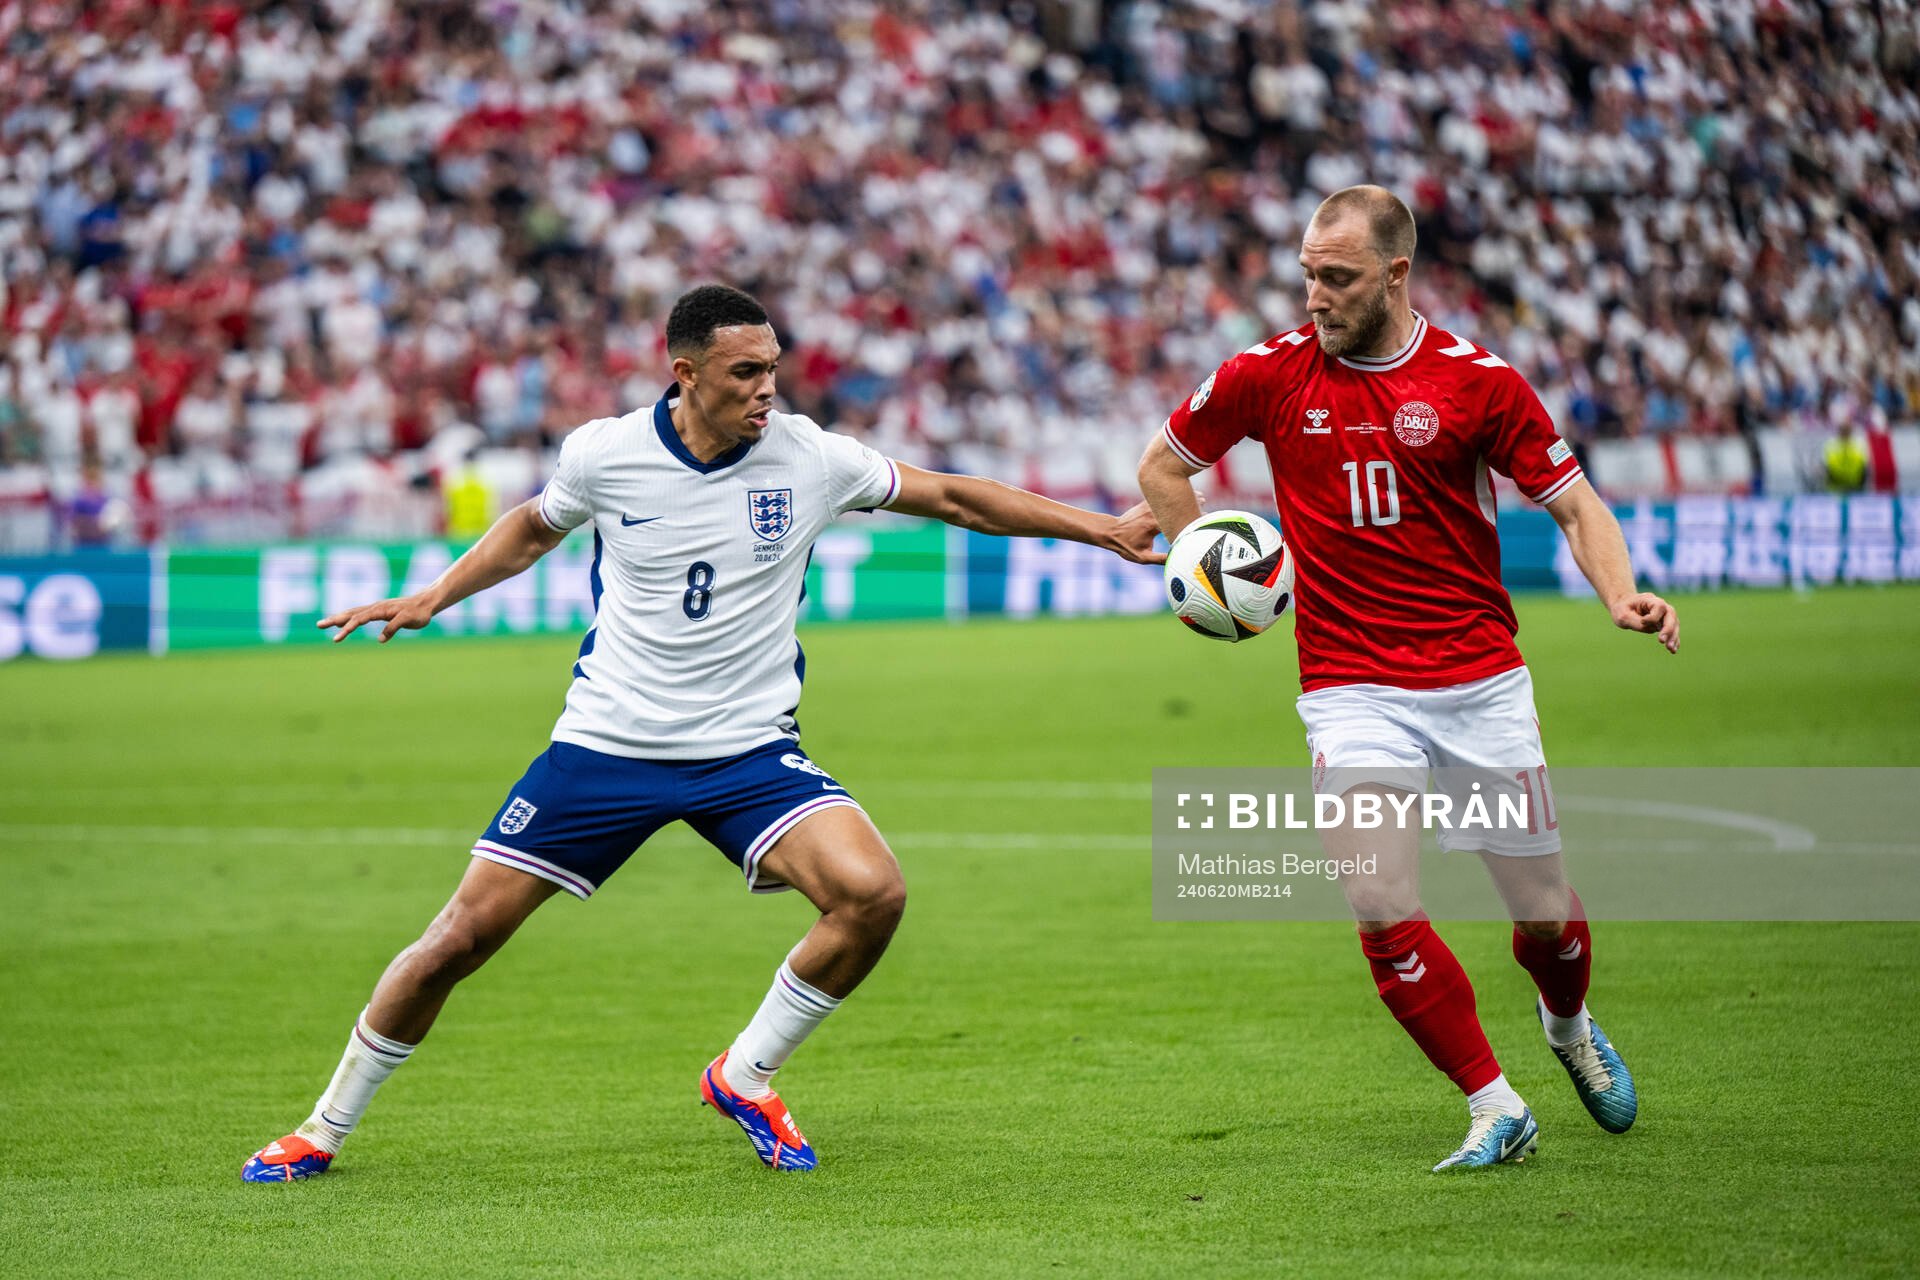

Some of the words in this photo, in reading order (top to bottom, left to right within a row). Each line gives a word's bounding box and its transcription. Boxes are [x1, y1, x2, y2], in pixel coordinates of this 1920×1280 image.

[1403, 415, 1430, 430] DBU
[1342, 461, 1401, 528] 10
[753, 543, 785, 552] DENMARK
[683, 561, 716, 621] 8
